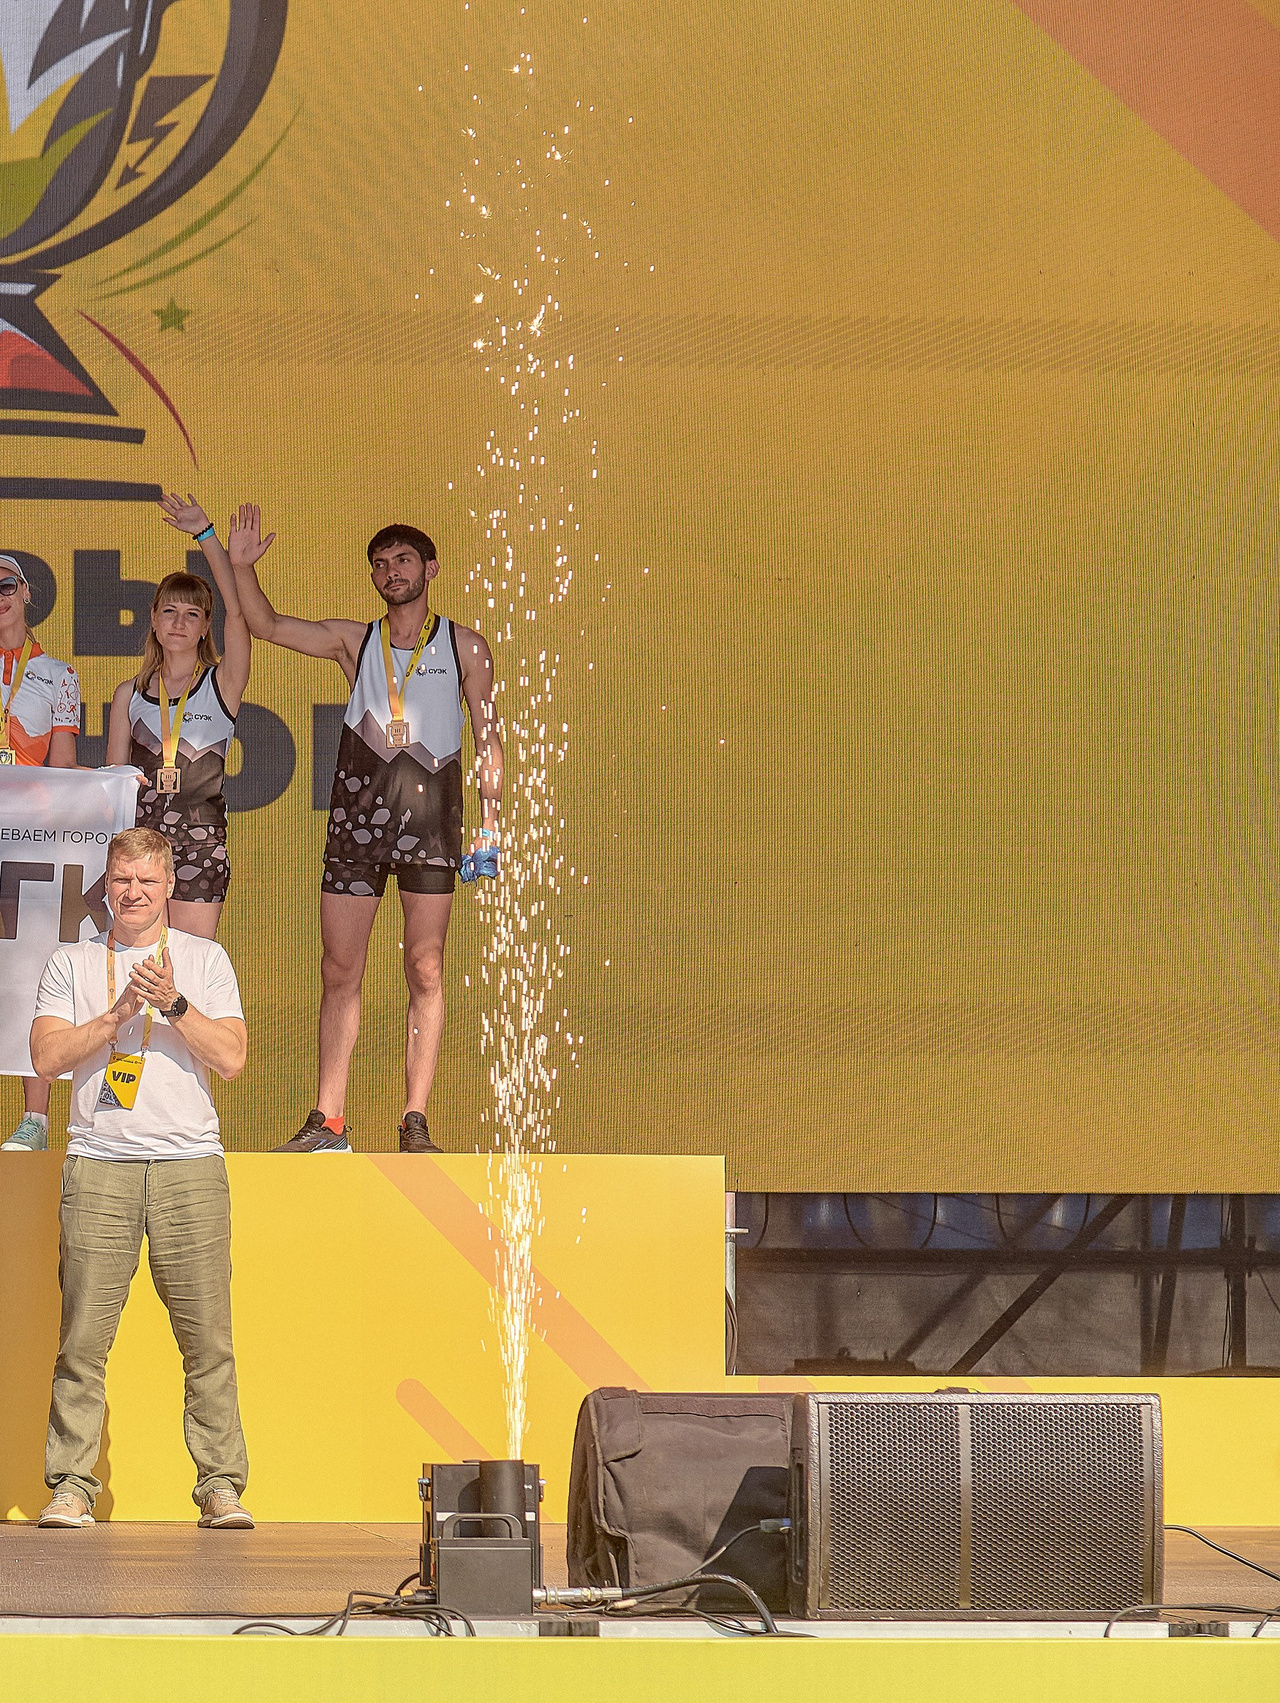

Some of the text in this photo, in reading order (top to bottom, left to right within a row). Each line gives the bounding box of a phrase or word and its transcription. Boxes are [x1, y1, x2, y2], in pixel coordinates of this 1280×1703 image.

[194, 713, 213, 722] СУЭК
[62, 830, 118, 845] ГОРО
[112, 1070, 137, 1084] VIP
